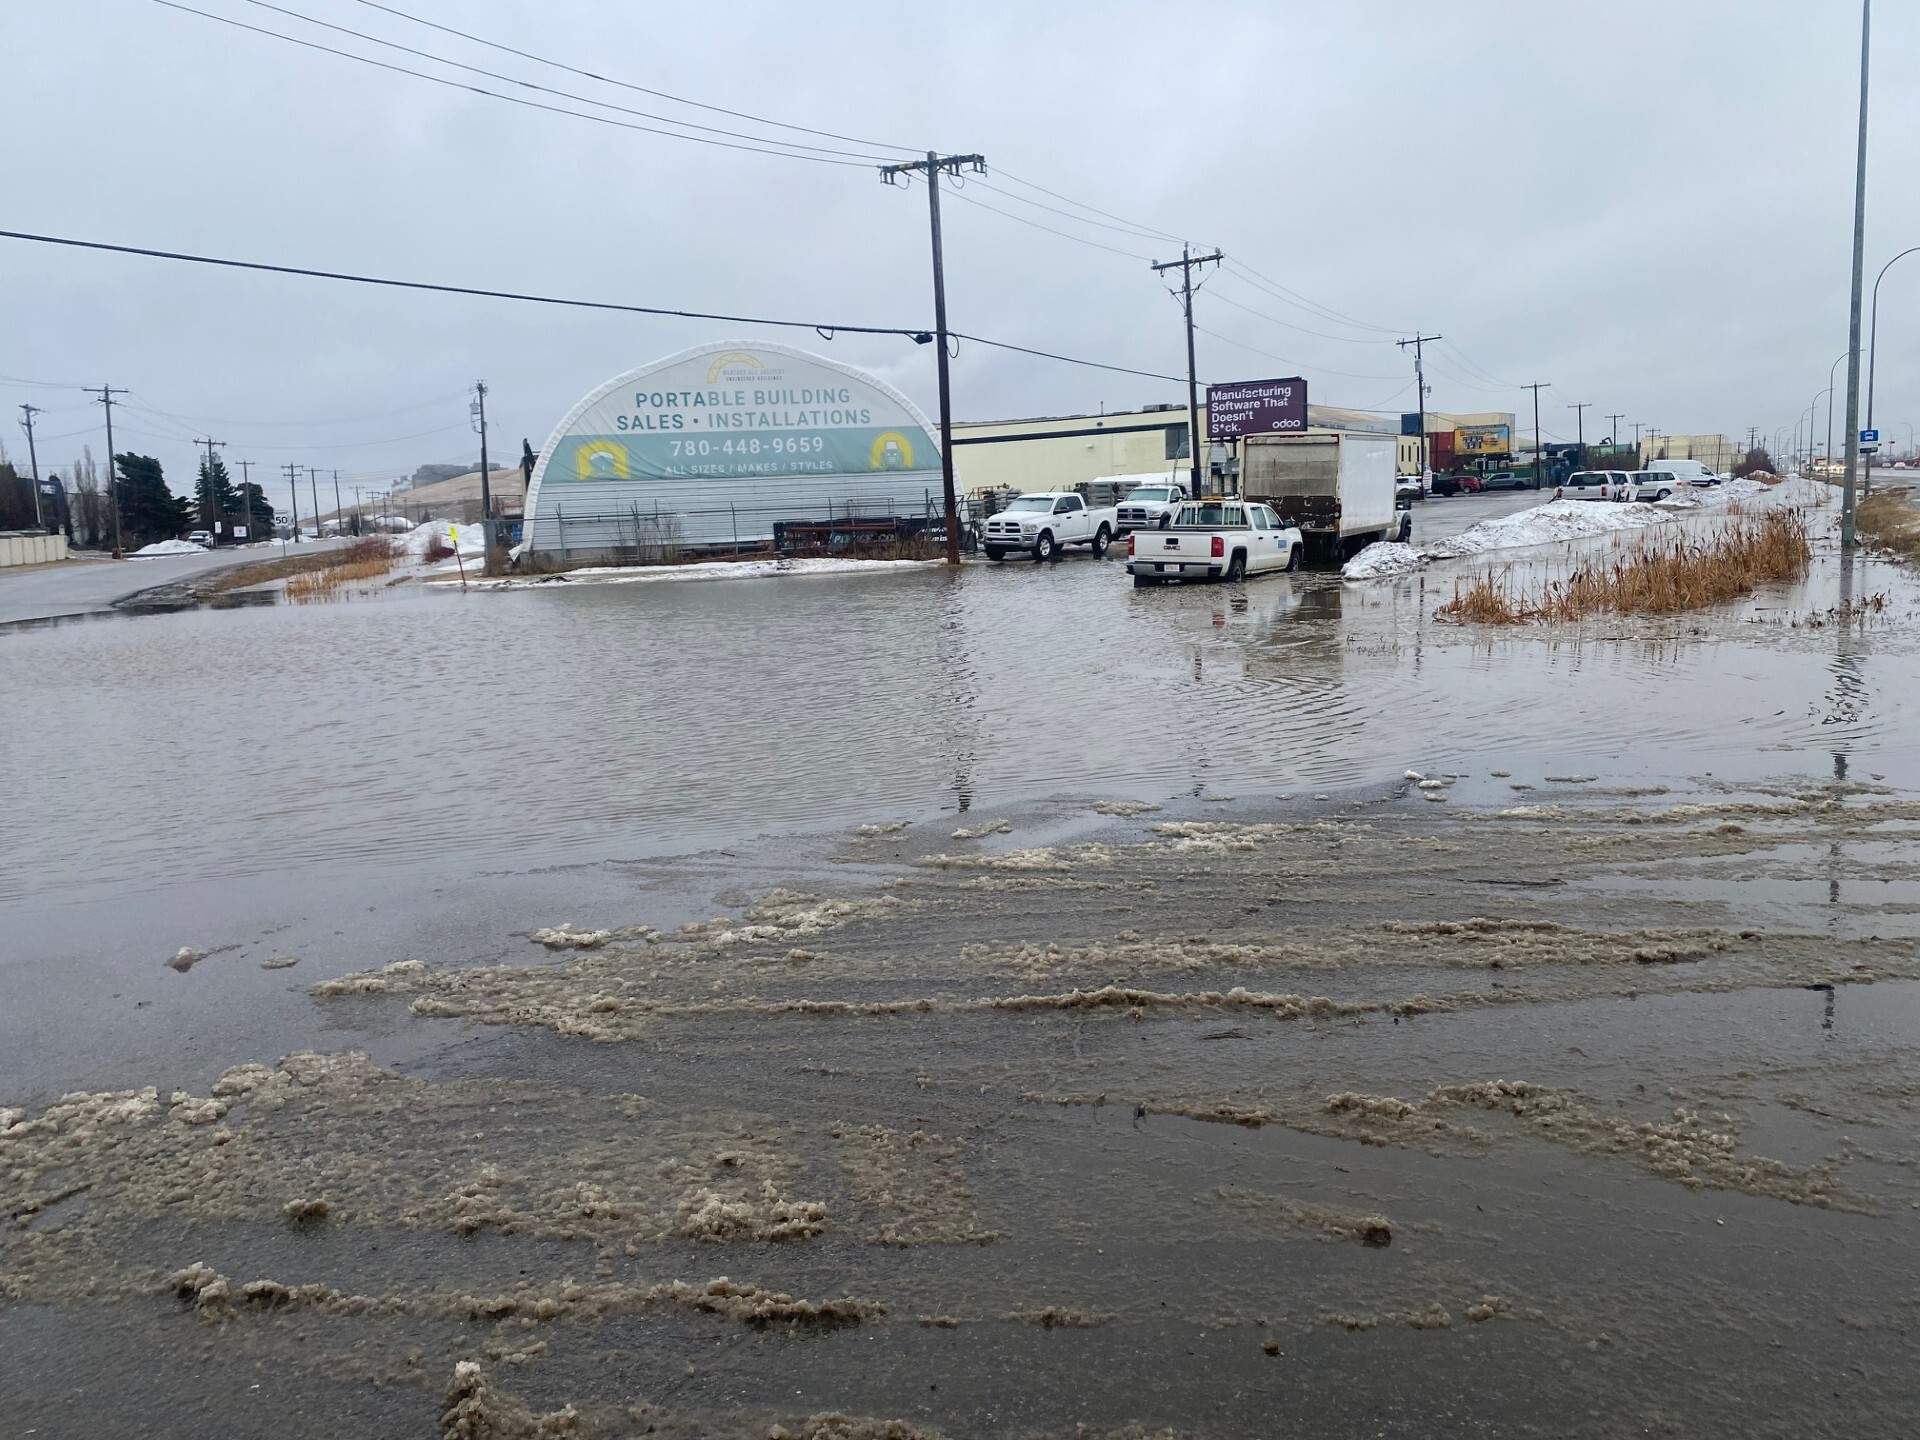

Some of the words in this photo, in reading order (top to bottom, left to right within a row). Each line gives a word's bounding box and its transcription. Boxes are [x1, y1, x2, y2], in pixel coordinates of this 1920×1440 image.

[635, 391, 746, 408] PORTABLE
[754, 388, 851, 406] BUILDING
[1211, 385, 1292, 402] Manufacturing
[1211, 400, 1261, 412] Software
[1262, 397, 1289, 408] That
[616, 413, 685, 431] SALES
[707, 408, 872, 429] INSTALLATIONS
[1211, 410, 1254, 423] Doesn't
[1272, 418, 1301, 429] odoo
[669, 436, 824, 458] 780-448-9659
[665, 464, 686, 476] ALL
[691, 463, 725, 475] SIZES
[737, 461, 778, 473] MAKES
[790, 460, 833, 472] STYLES
[275, 516, 288, 524] 50
